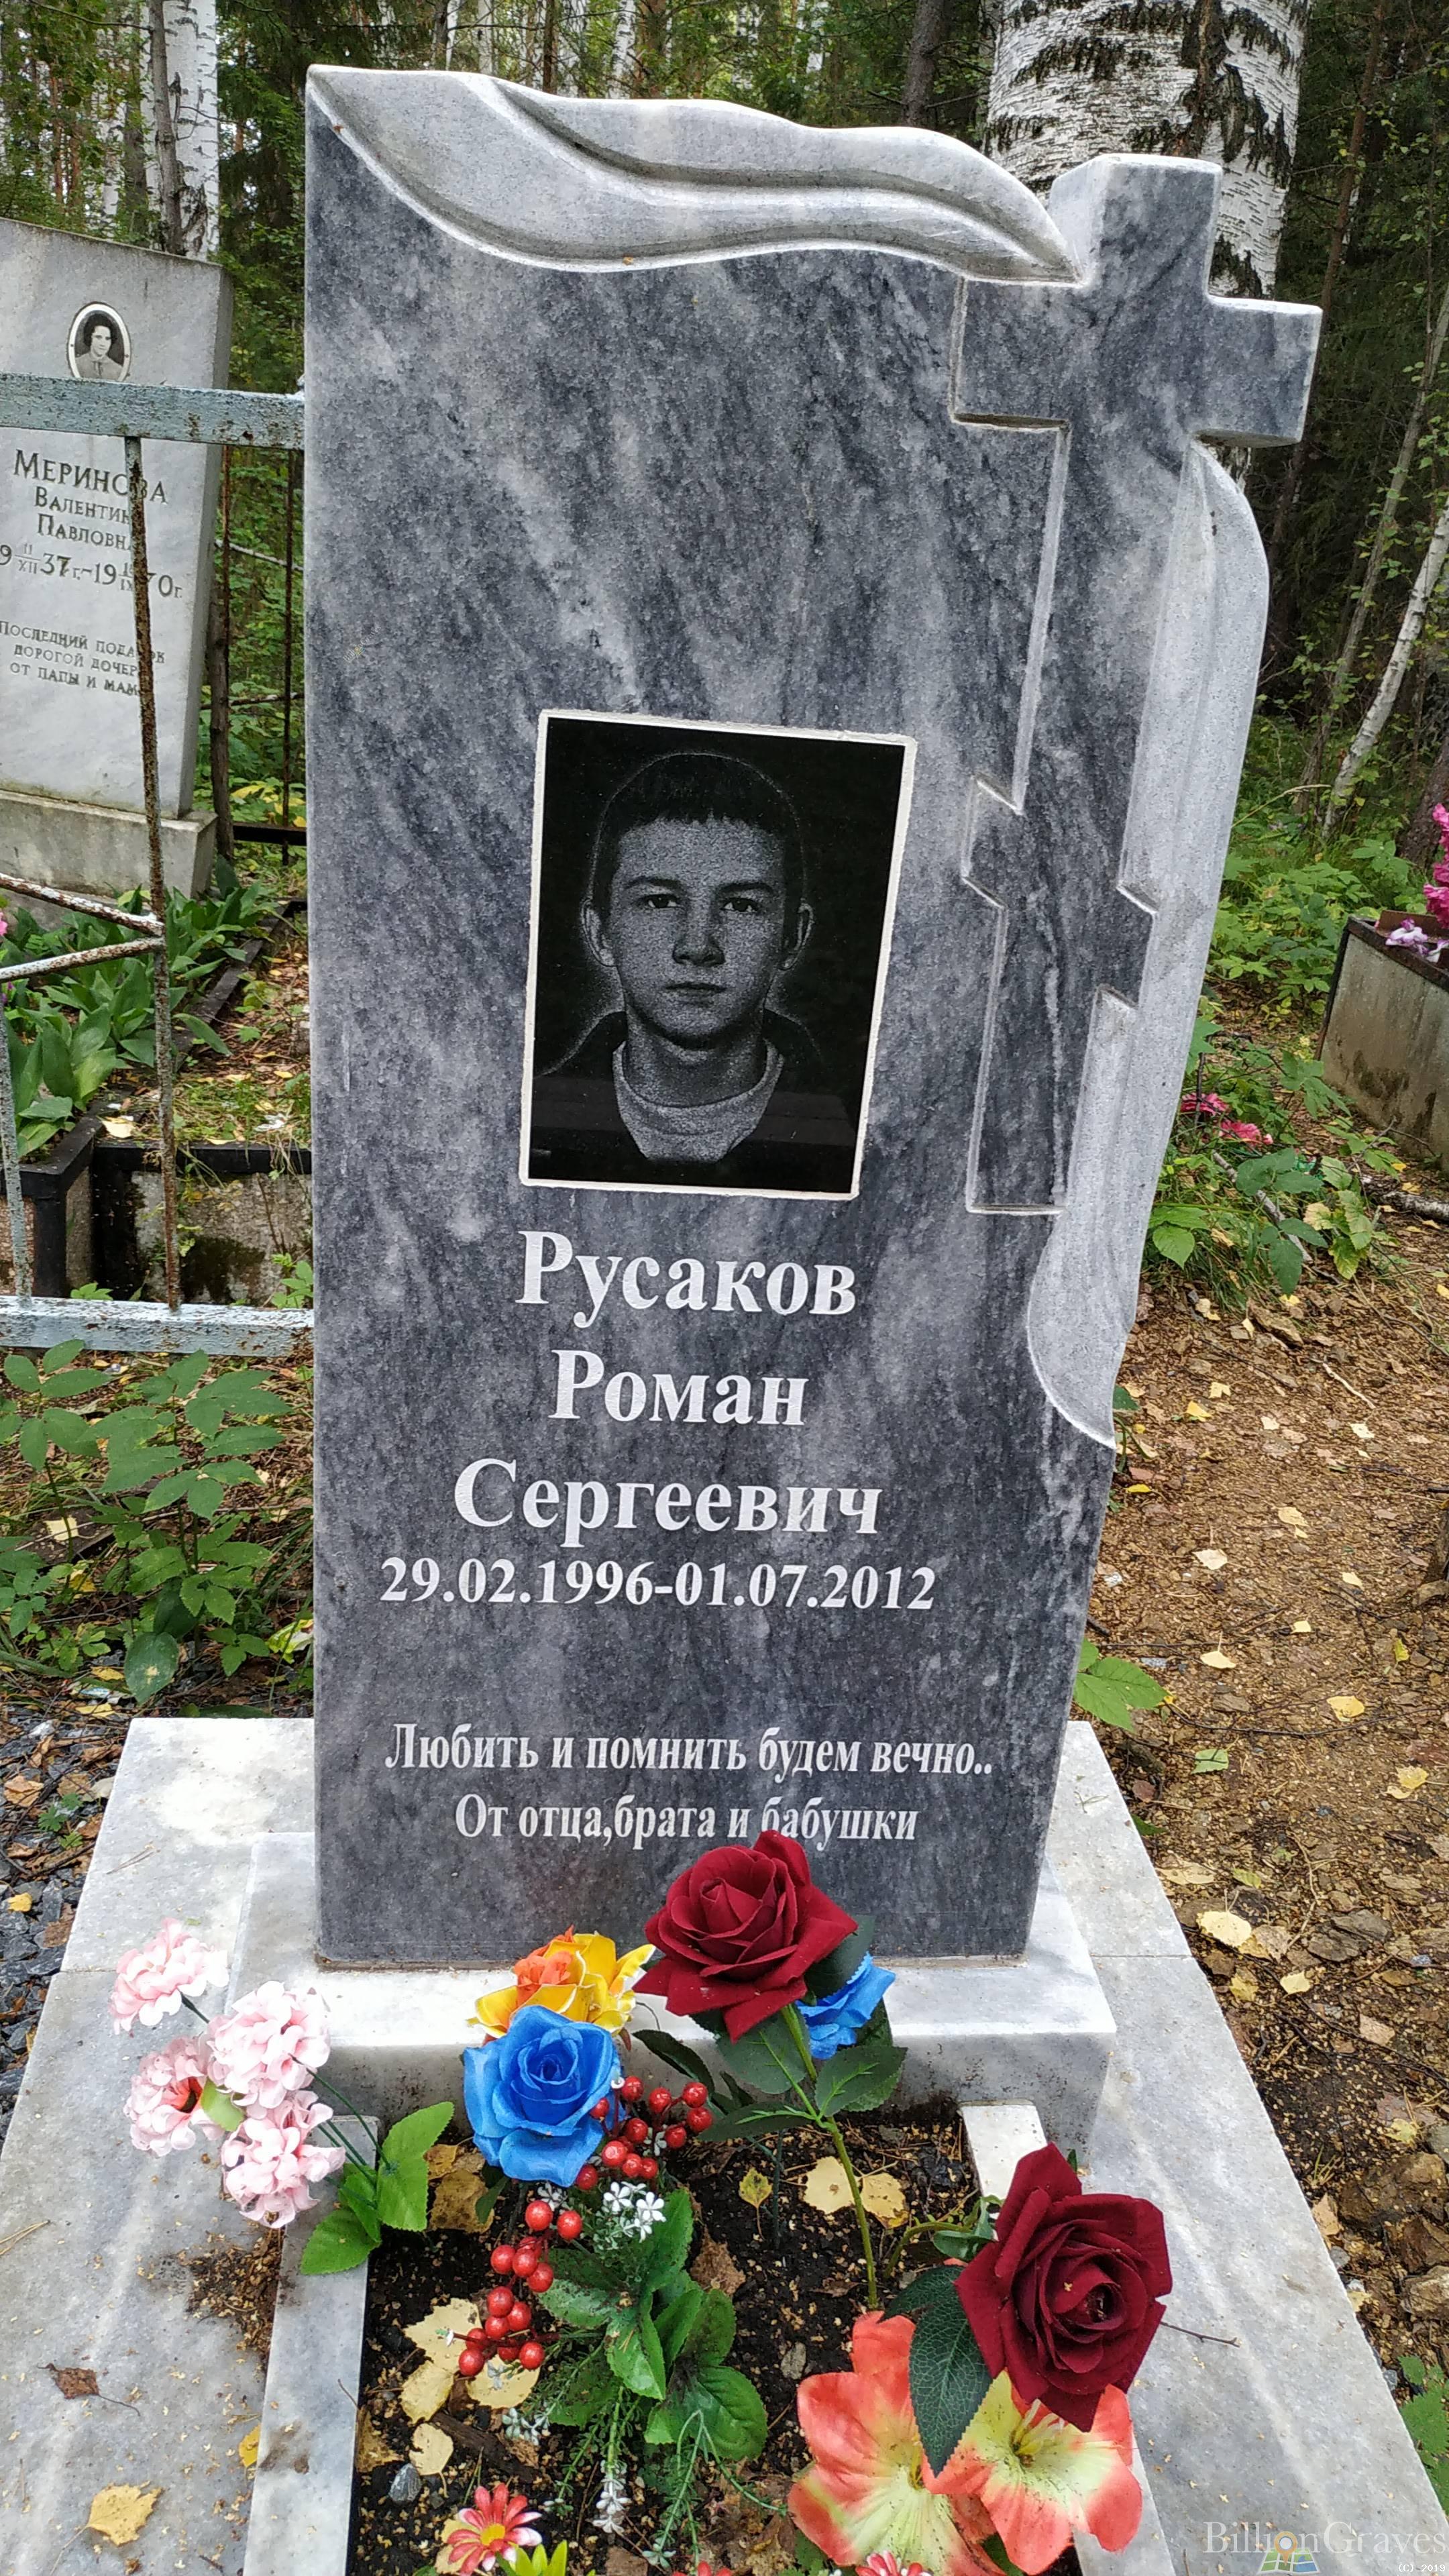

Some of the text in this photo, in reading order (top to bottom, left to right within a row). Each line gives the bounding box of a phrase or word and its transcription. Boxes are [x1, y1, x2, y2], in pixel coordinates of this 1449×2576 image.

[34, 486, 131, 525] ВАЛЕНТИН
[37, 513, 133, 551] ПАВЛОВН
[0, 621, 165, 663] ПОСЛЕДНИЙ ПОДАК
[14, 644, 138, 676] ДОРОГОЙ ДОЧЕР
[10, 662, 141, 696] ОТ ПАПЫ И МАМ
[515, 1230, 856, 1328] Русаков
[548, 1349, 809, 1426] Роман
[453, 1458, 883, 1548] Сергеевич
[380, 1556, 936, 1610] 29.02.1996-01.07.2012
[385, 1723, 992, 1784] Любить и помнить будем вечно..
[455, 1794, 508, 1838] От
[727, 1808, 751, 1838] и
[761, 1796, 919, 1851] бабушки
